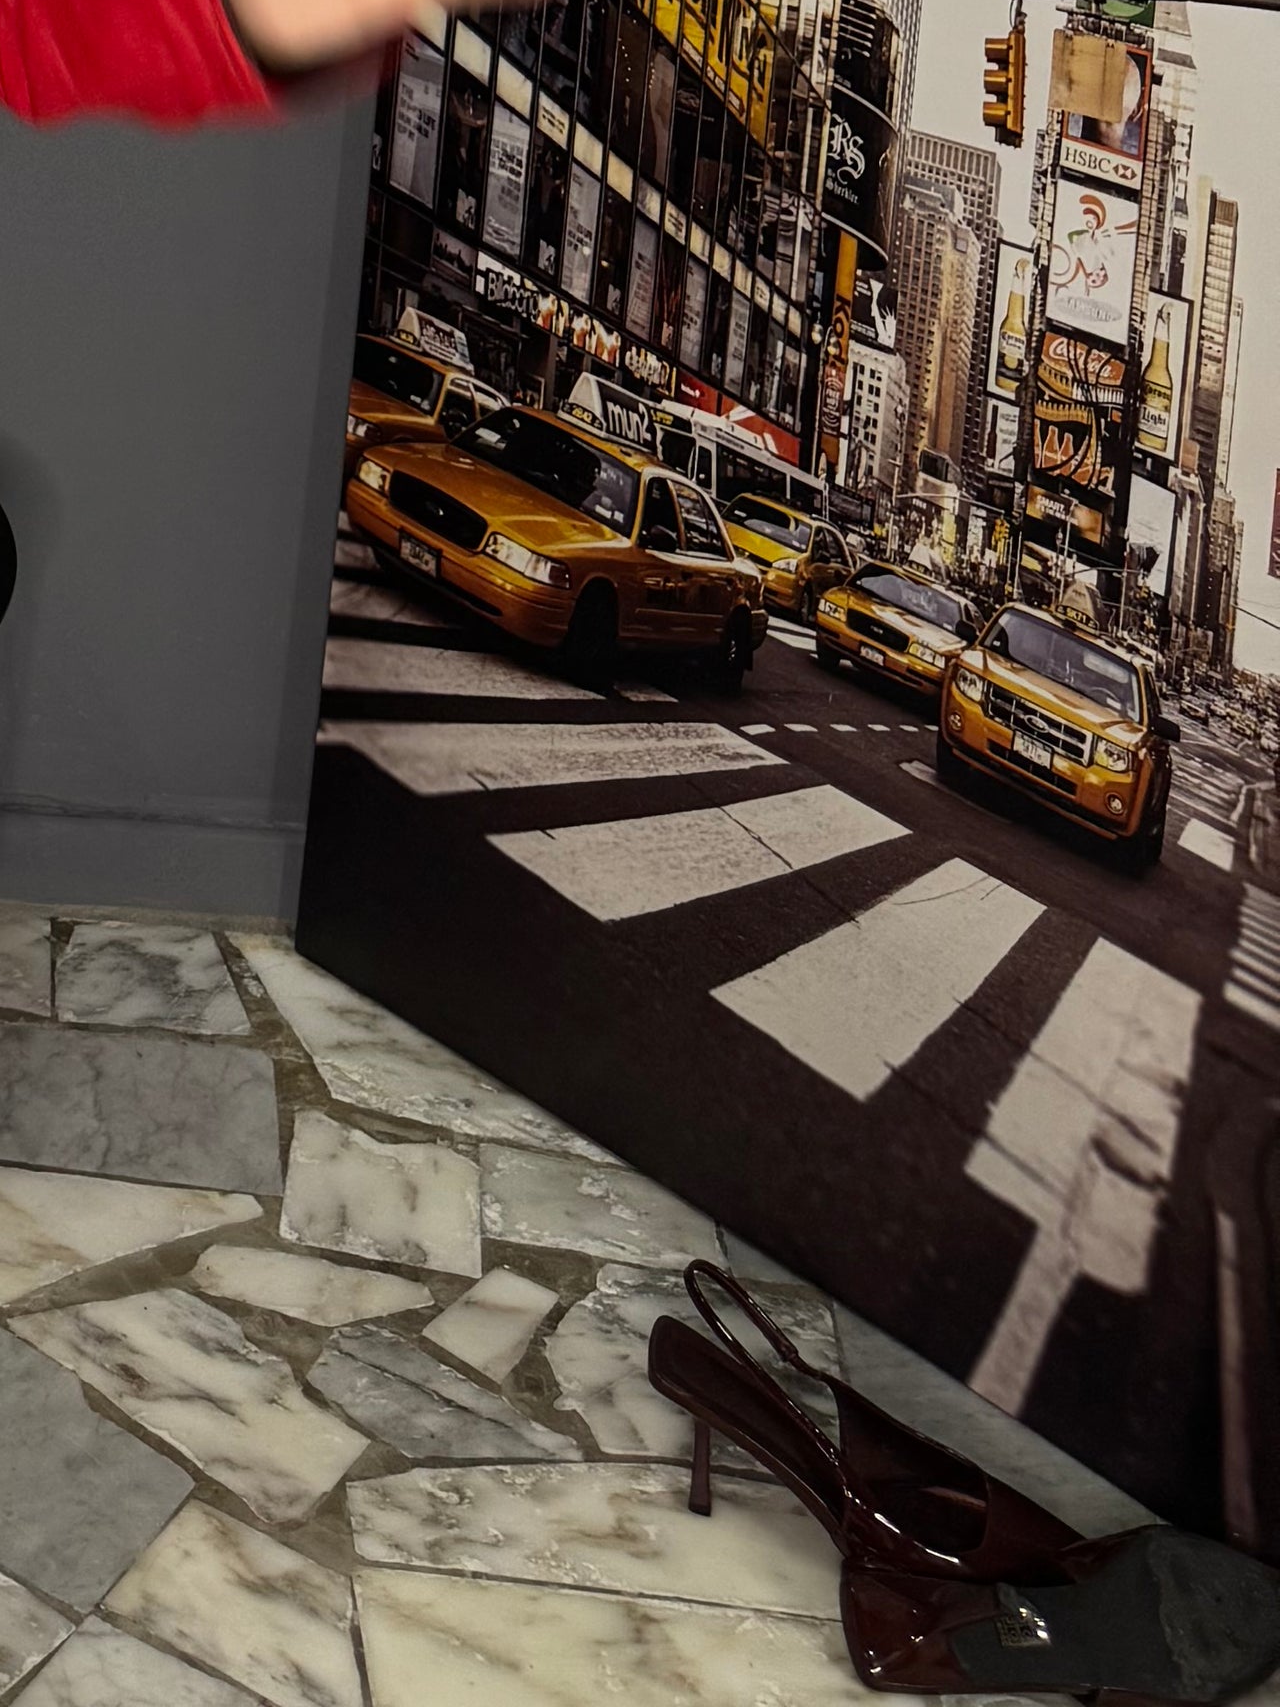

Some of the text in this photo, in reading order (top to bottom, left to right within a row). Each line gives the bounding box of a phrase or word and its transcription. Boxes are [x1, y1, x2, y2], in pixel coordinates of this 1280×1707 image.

[1064, 146, 1112, 174] HSBC
[606, 401, 653, 445] mun2
[1142, 407, 1167, 426] Light
